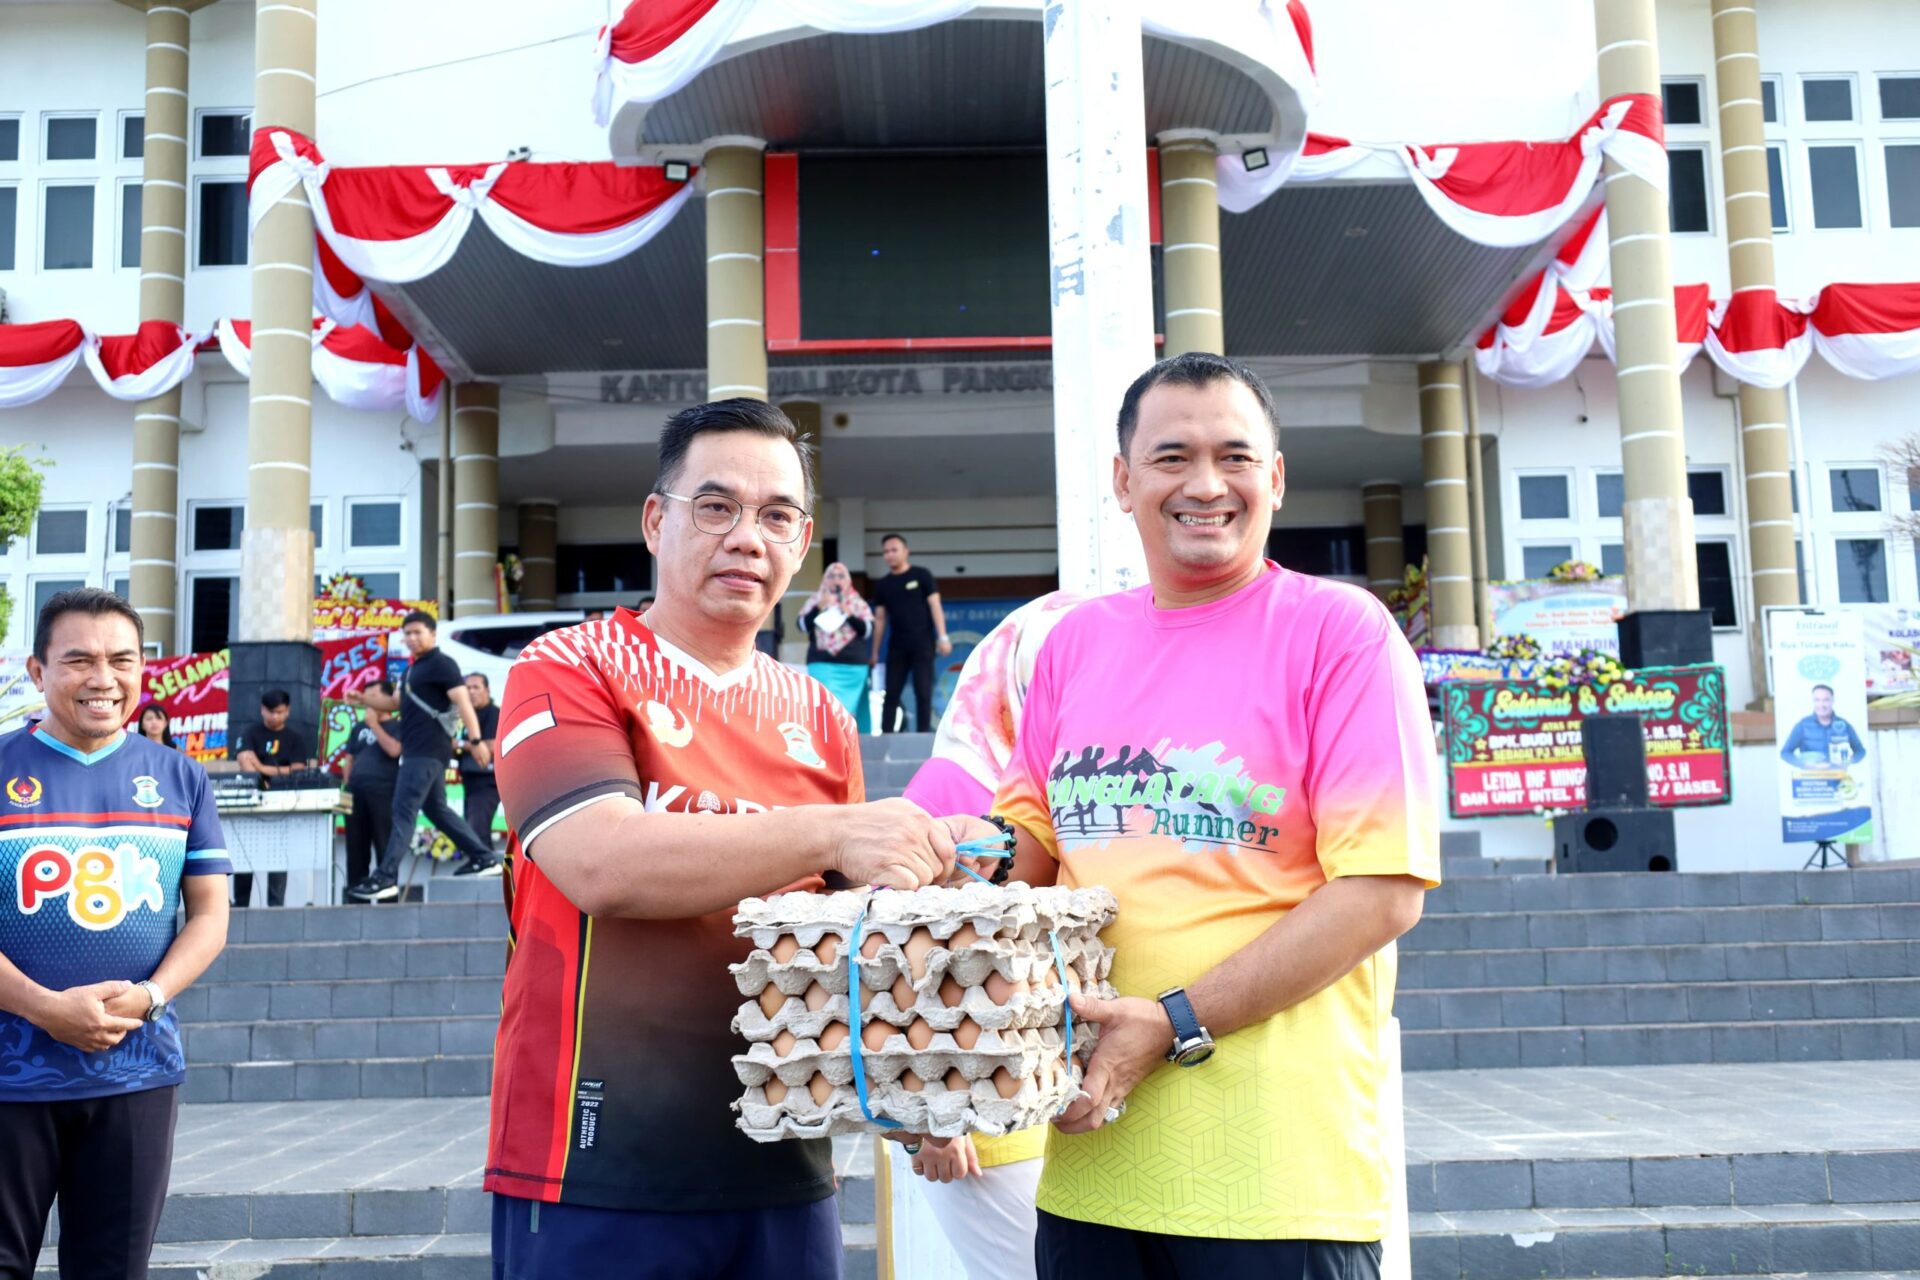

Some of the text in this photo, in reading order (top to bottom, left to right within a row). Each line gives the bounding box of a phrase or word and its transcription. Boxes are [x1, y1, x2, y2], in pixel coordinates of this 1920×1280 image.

[601, 373, 706, 402] KANTO
[942, 364, 1052, 394] PANGK
[1493, 688, 1573, 719] Selamat
[1552, 744, 1584, 759] WALIK
[1645, 739, 1683, 754] PINANG
[1555, 729, 1582, 745] UTA
[1459, 791, 1488, 807] DAN
[1491, 789, 1525, 805] UNIT
[1673, 779, 1722, 796] BASEL
[1482, 770, 1522, 791] LETDA
[1549, 767, 1587, 788] MING
[1150, 807, 1280, 846] Runner
[18, 844, 165, 930] pgk
[580, 1108, 589, 1149] AUTHENTIC
[587, 1112, 596, 1147] PRODUCT
